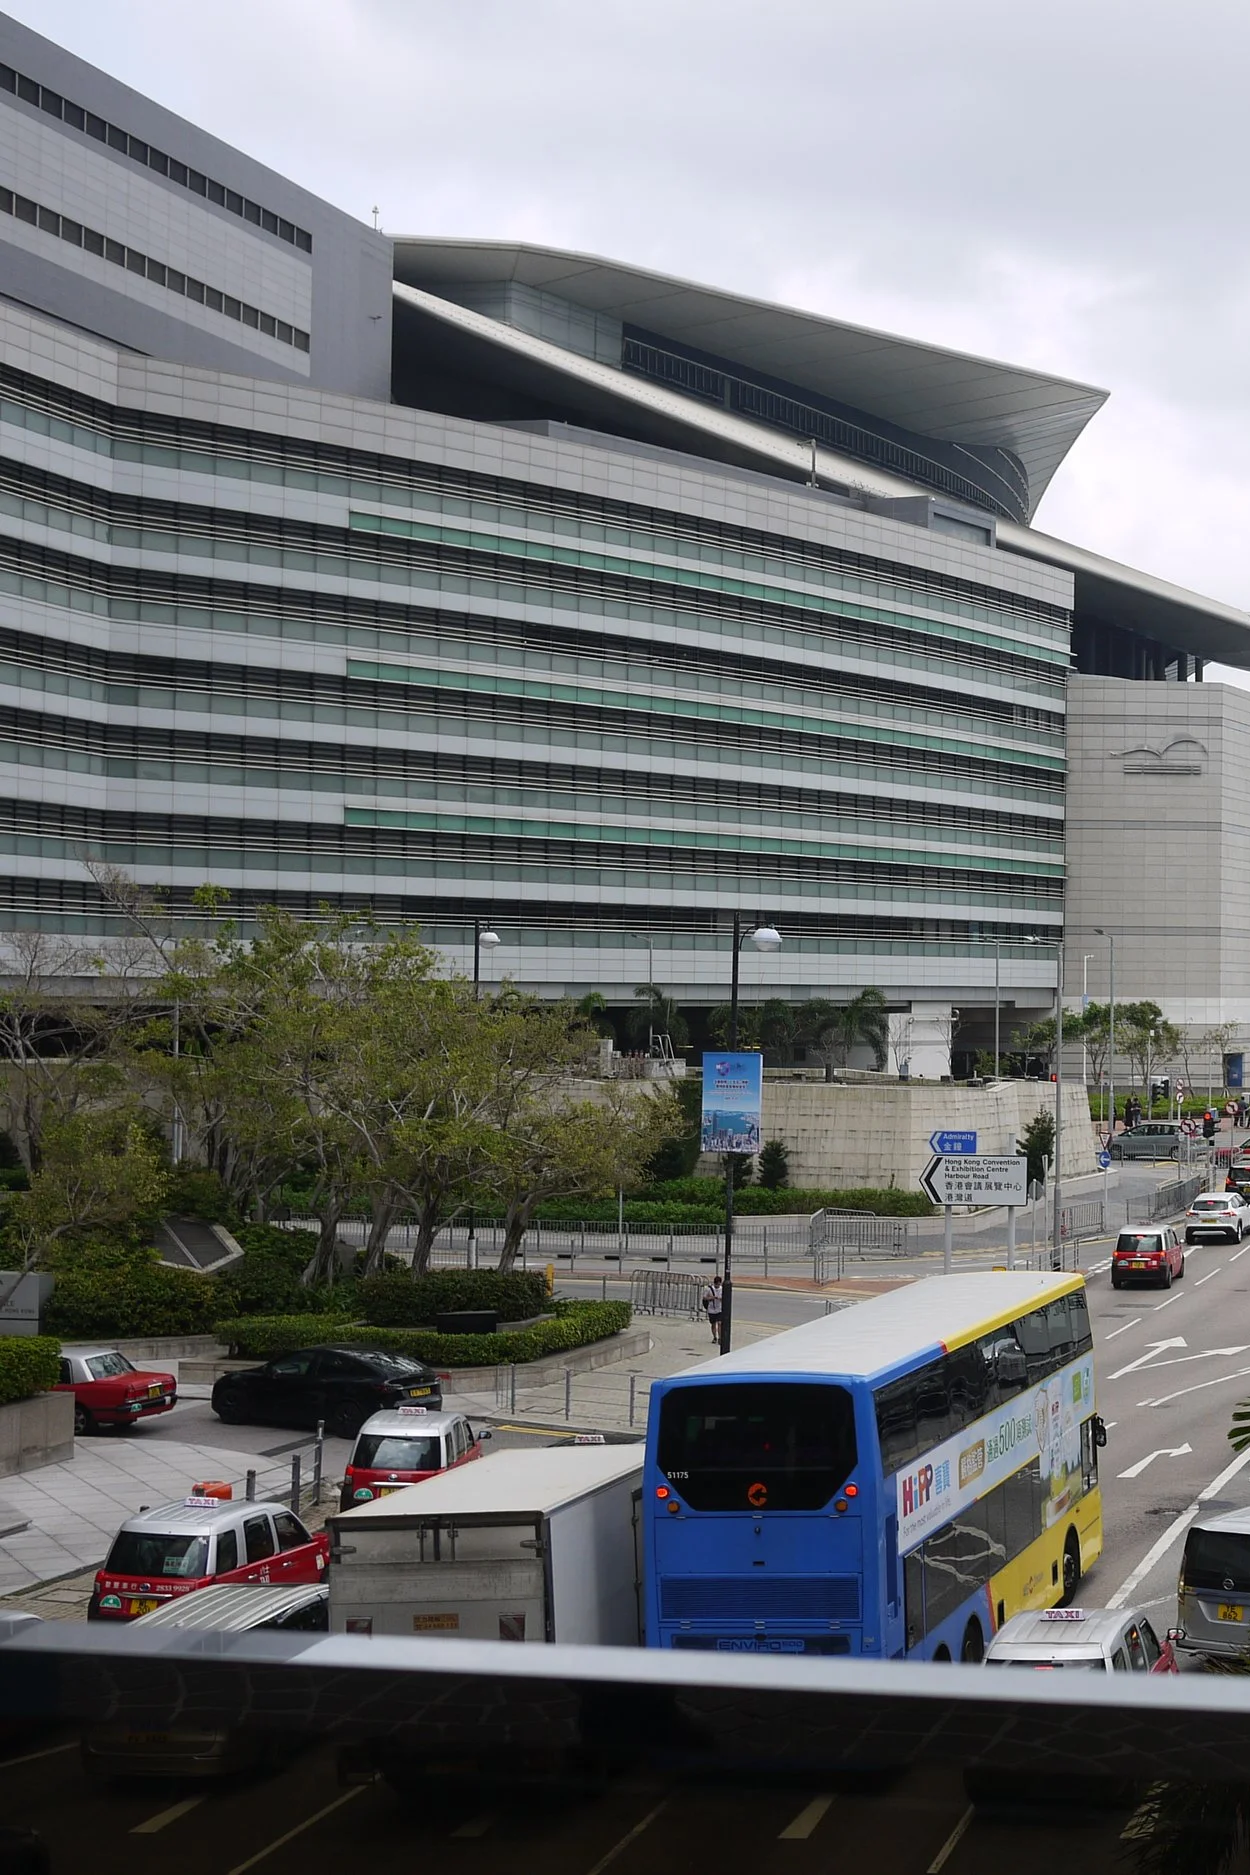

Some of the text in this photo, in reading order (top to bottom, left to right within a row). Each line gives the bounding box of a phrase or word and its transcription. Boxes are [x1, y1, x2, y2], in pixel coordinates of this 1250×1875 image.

[942, 1133, 974, 1141] Admiralty
[943, 1142, 962, 1151] 金鐘
[944, 1158, 1020, 1166] Hong Kong Convention
[951, 1165, 985, 1173] Exhibition
[944, 1181, 1022, 1192] 香港會議展覽中心
[667, 1471, 689, 1479] 51175
[902, 1463, 934, 1518] HiPP
[188, 1497, 216, 1506] TAXI
[1045, 1610, 1080, 1619] TAXI
